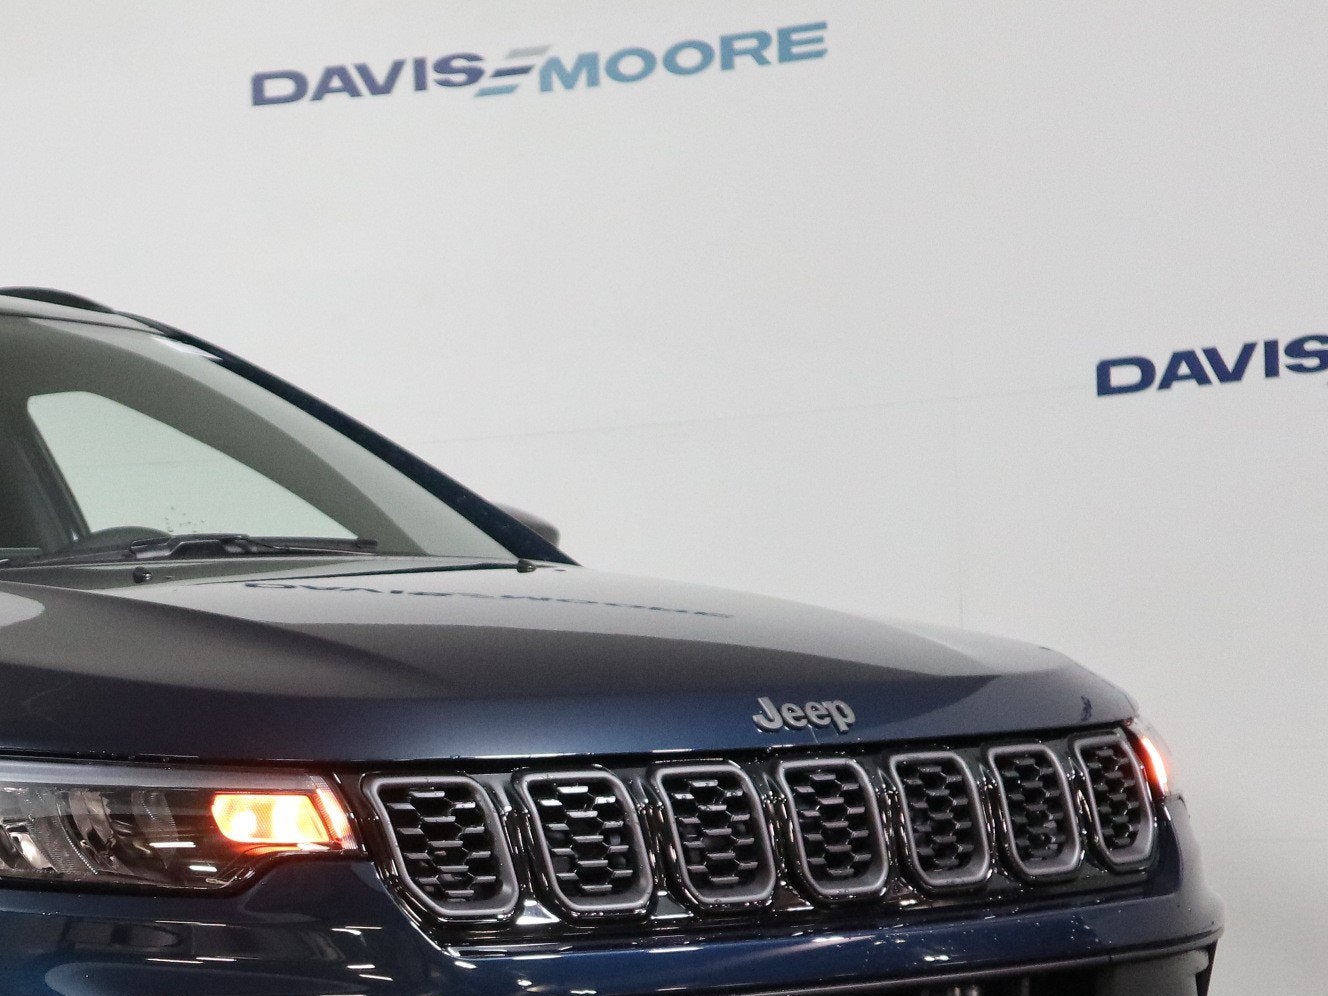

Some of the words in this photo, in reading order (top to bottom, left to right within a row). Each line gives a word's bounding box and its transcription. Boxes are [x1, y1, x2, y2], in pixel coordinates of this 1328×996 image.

[250, 53, 486, 107] DAVIS
[538, 21, 829, 94] MOORE
[1095, 333, 1328, 398] DAVIS
[752, 696, 856, 733] Jeep
